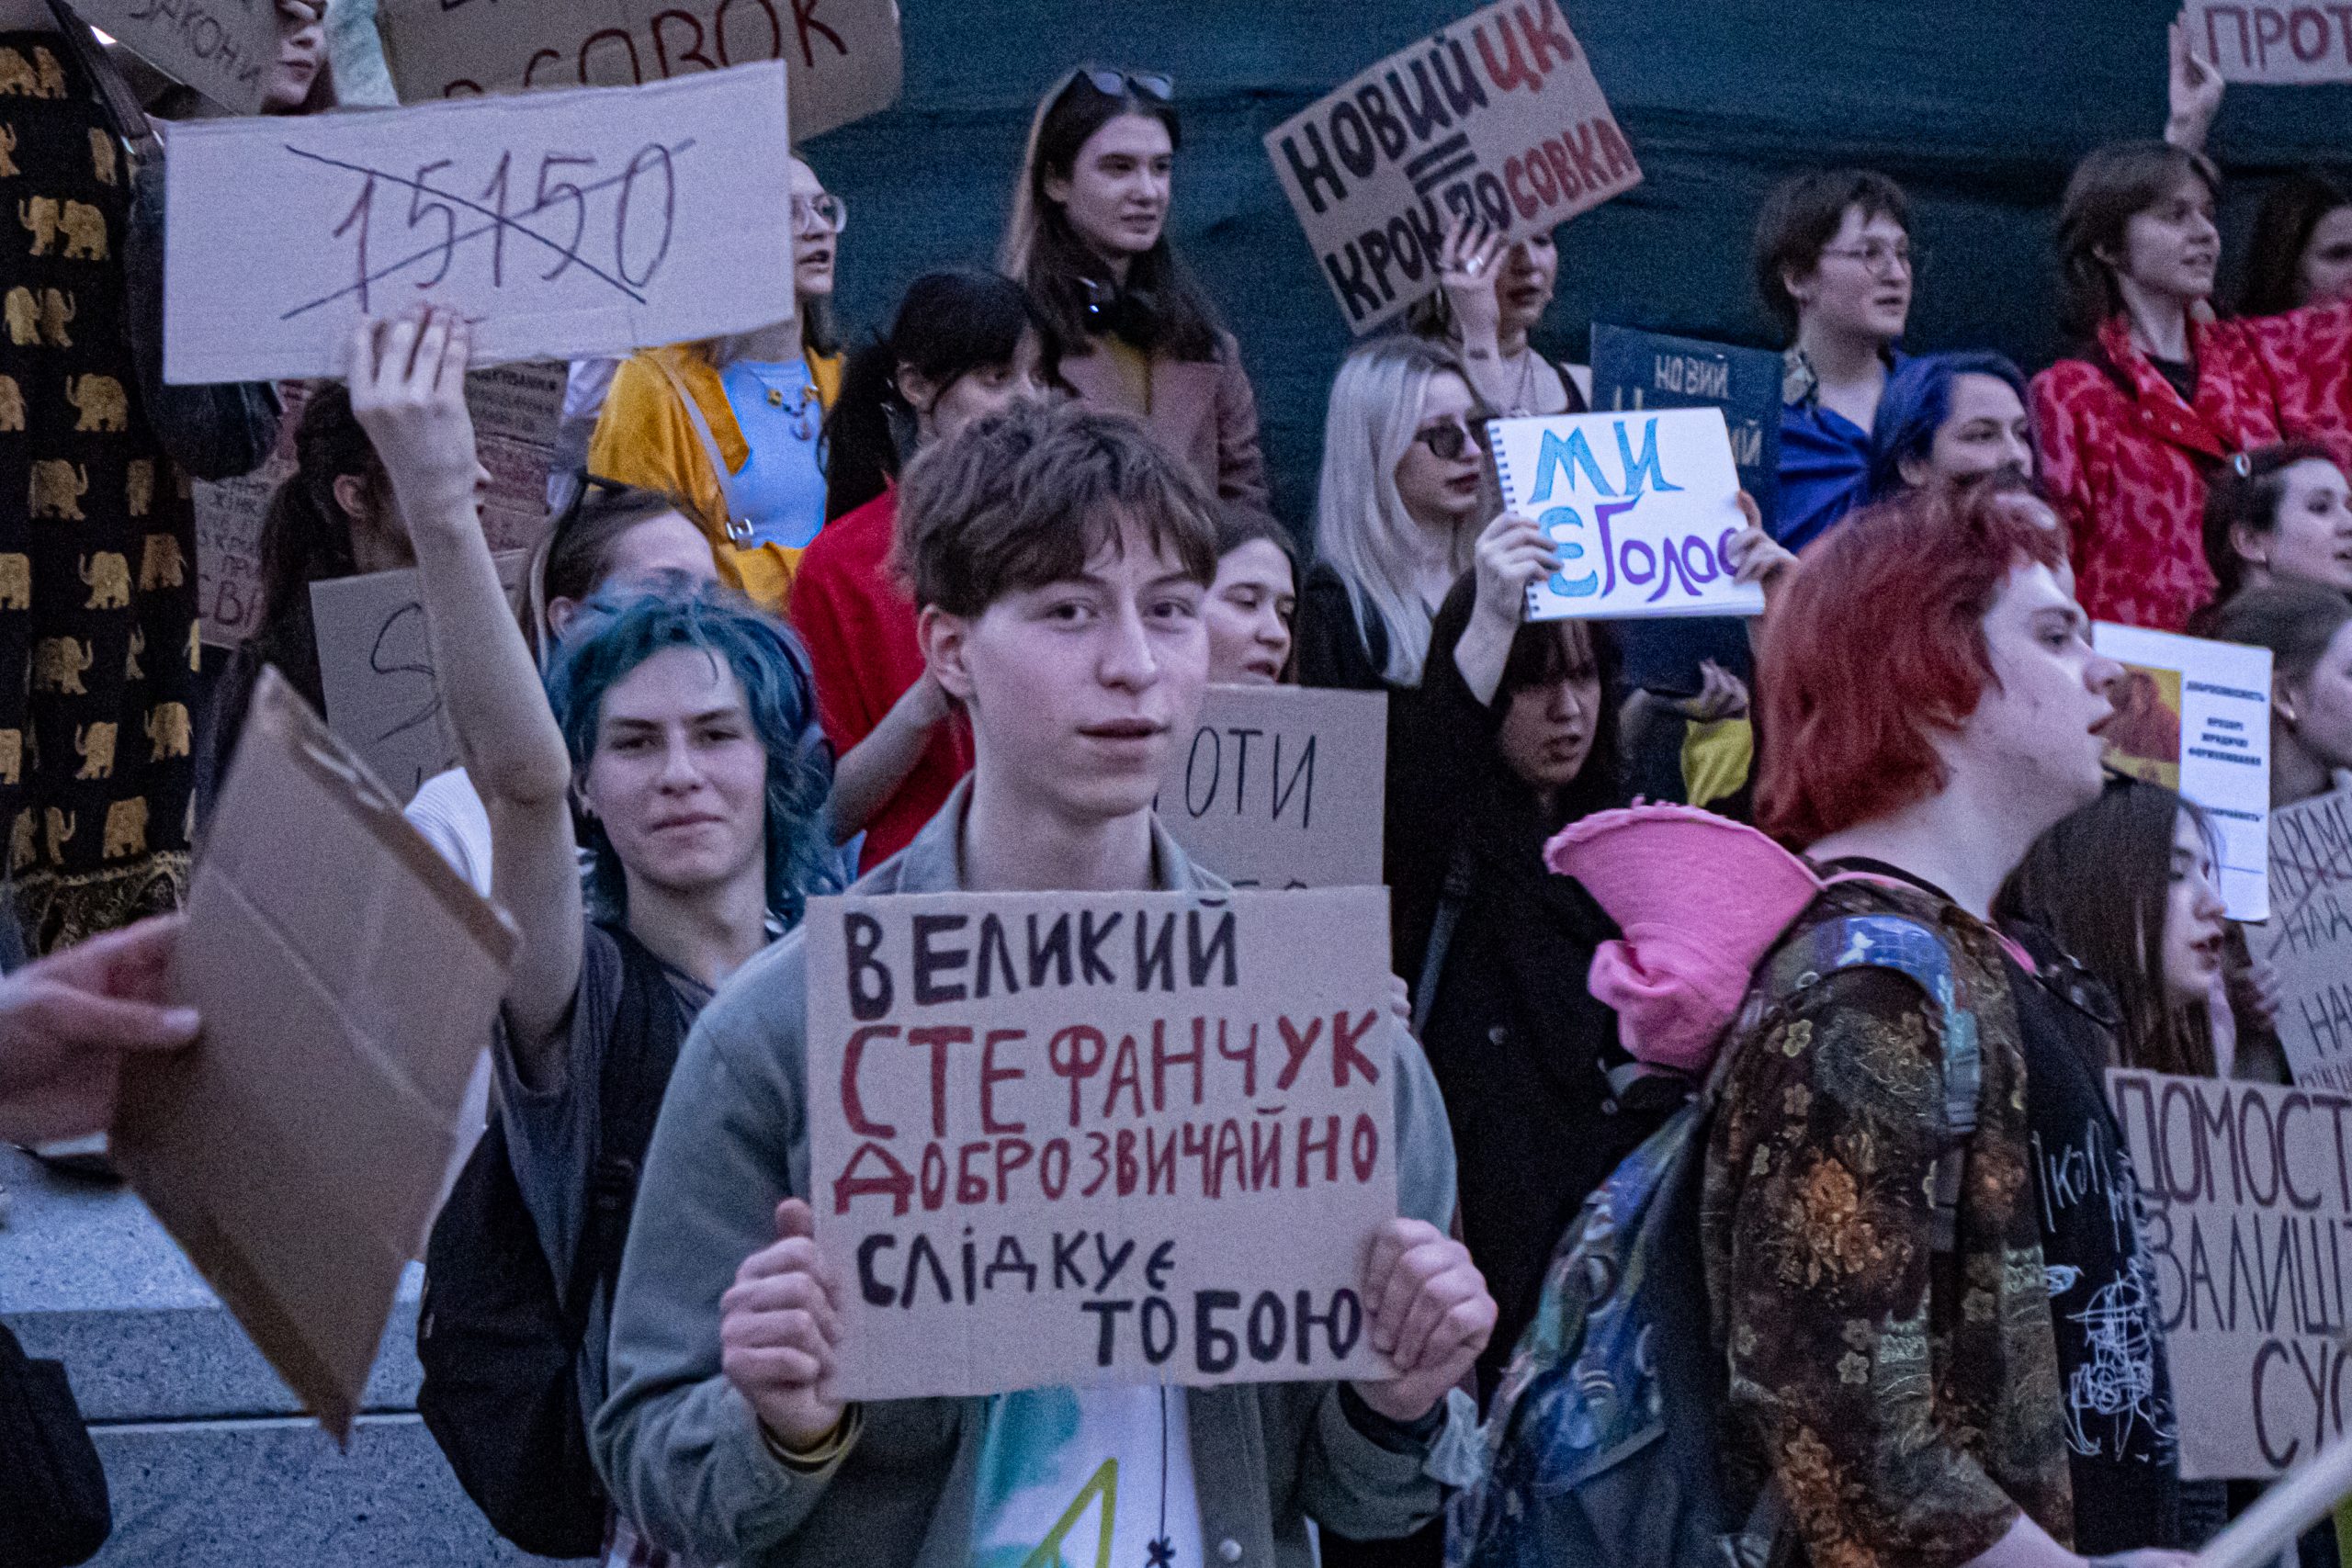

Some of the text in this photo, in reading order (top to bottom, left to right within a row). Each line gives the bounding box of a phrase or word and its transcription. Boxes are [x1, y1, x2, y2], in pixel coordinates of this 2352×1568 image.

[1281, 0, 1575, 215] НОВИЙ ЦК
[1325, 196, 1446, 321] КРОК
[1504, 118, 1635, 220] СОВКА
[1527, 417, 1685, 504] МИ
[1152, 725, 1317, 830] ОТИ
[842, 897, 1239, 1021] ВЕЛИКИЙ
[840, 1009, 1380, 1140] СТЕФАНЧУК
[832, 1105, 1378, 1217] ДОБРОЗВИЧАЙНО
[1080, 1287, 1363, 1374] ТОБОЮ
[2144, 1209, 2352, 1334] ЗАЛИШ
